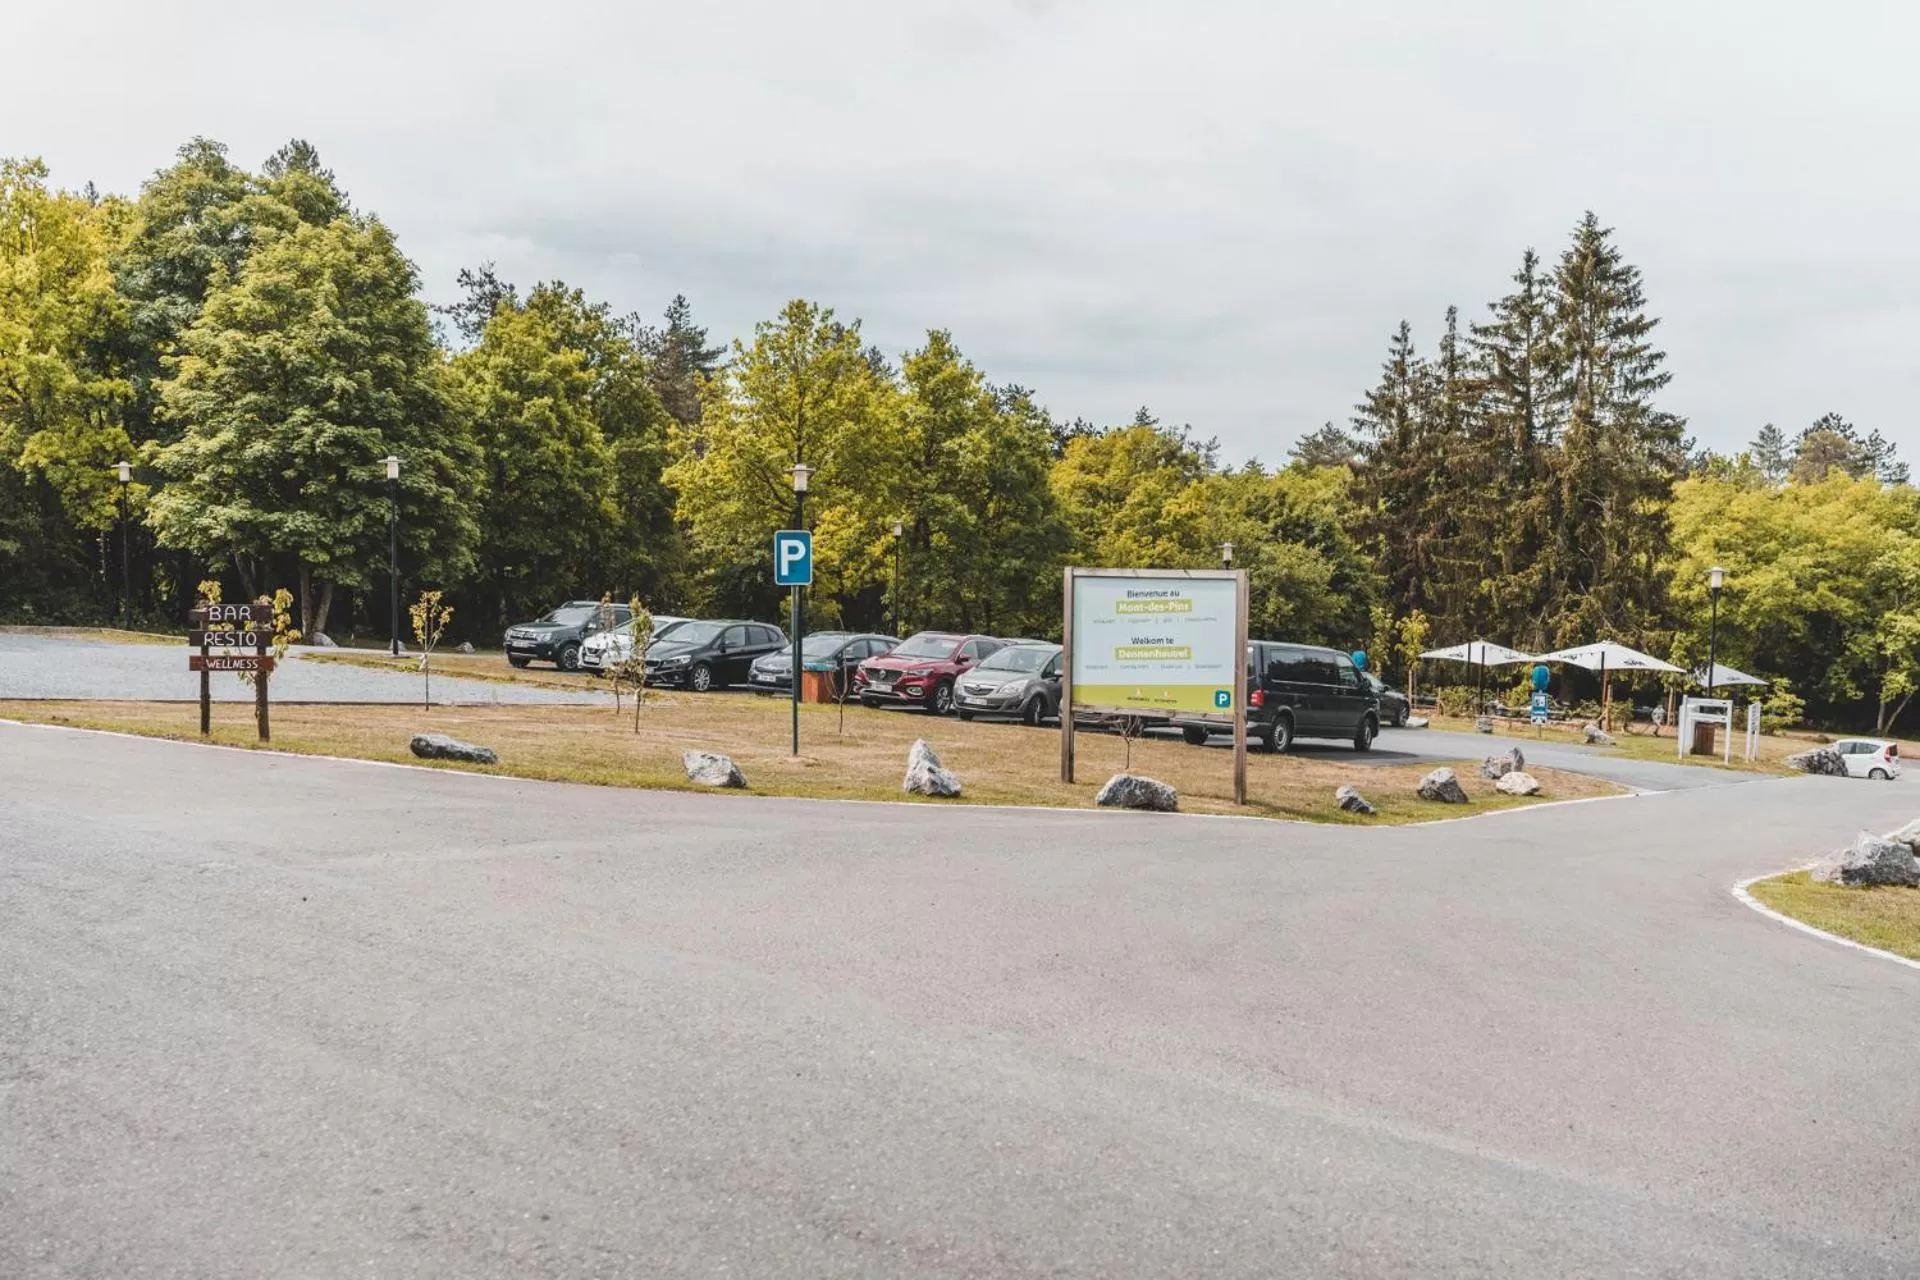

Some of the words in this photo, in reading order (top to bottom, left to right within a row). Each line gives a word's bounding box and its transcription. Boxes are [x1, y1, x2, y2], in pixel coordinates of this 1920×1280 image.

[780, 539, 806, 576] P
[1127, 590, 1168, 598] Bienvenue
[1118, 602, 1189, 612] Mont-des-Pins
[209, 606, 251, 621] BAR
[204, 631, 257, 646] RESTO
[1131, 637, 1164, 645] Welkom
[1165, 637, 1174, 645] te
[205, 657, 258, 669] WELLNESS
[1219, 693, 1228, 705] P
